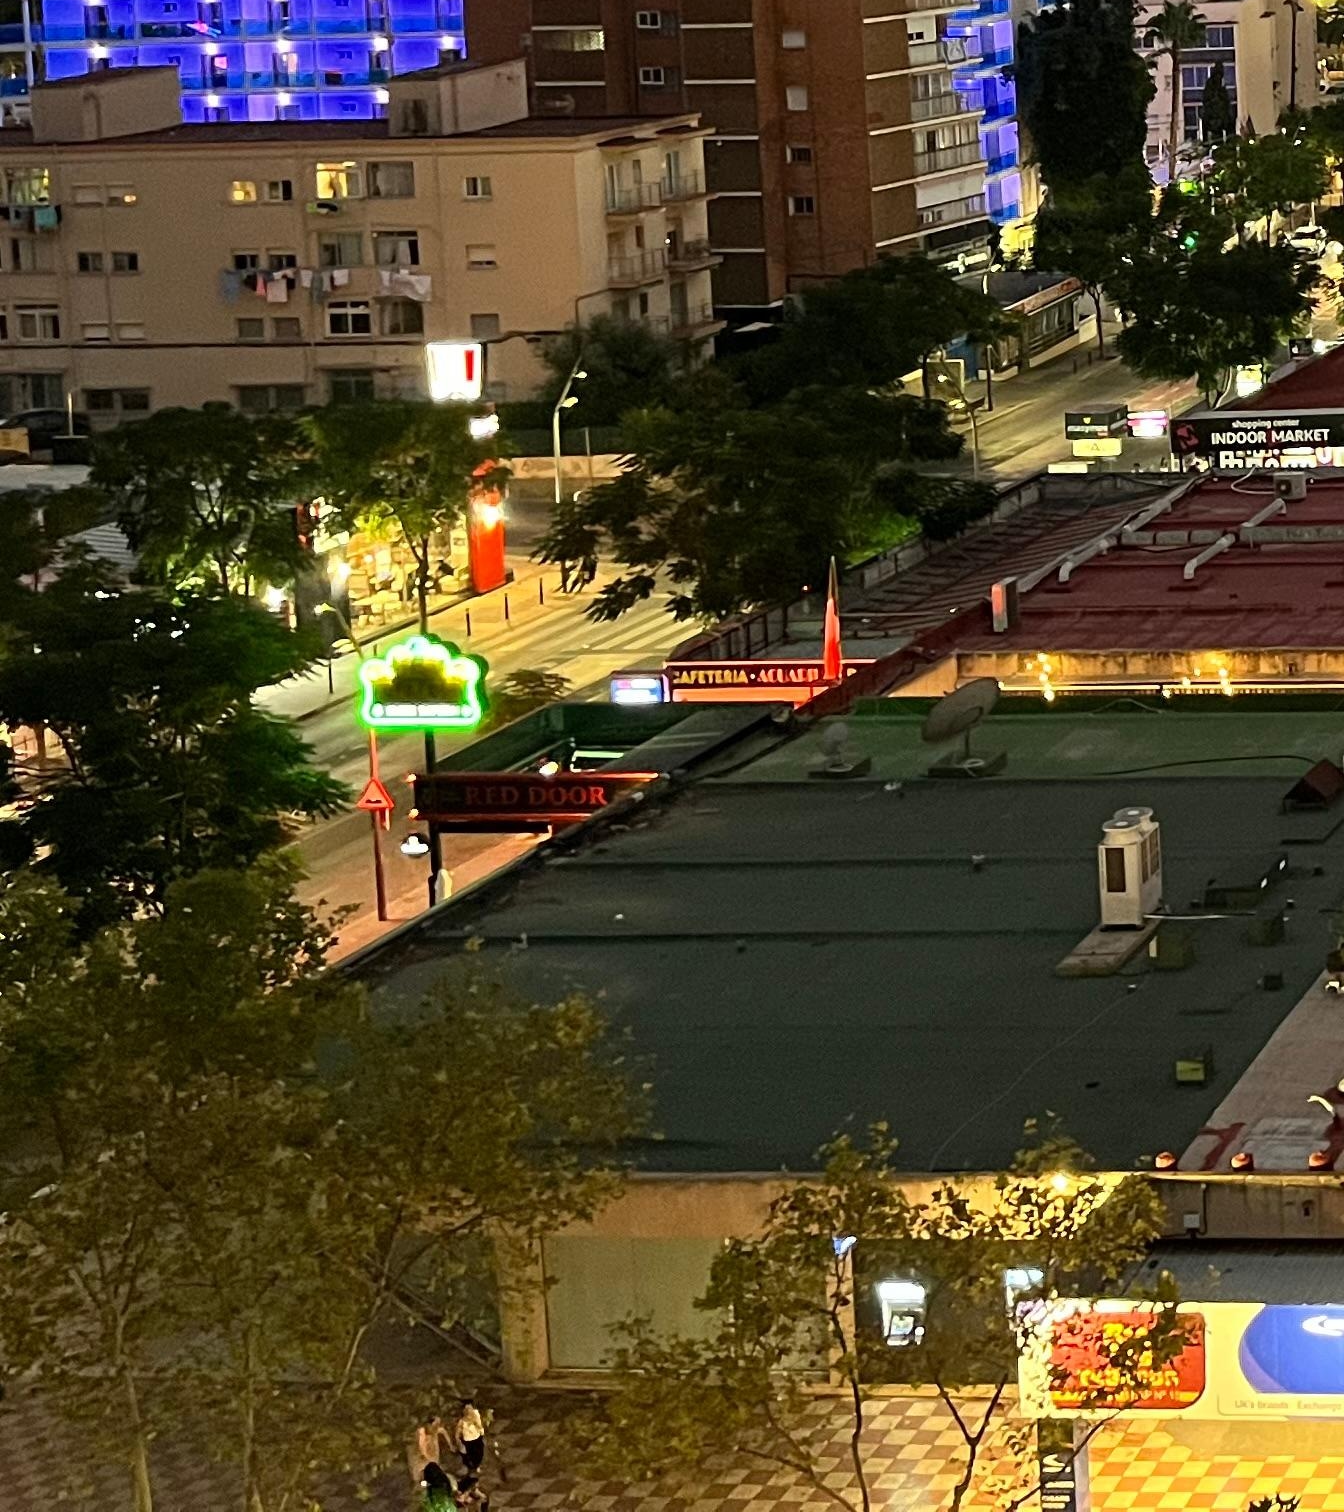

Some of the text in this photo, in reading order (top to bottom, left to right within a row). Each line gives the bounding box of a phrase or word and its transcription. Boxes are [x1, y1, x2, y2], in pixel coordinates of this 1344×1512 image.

[1231, 418, 1300, 430] shopping center
[1211, 428, 1331, 445] INDOOR MARKET
[465, 786, 519, 805] RED
[528, 786, 608, 806] DOOR
